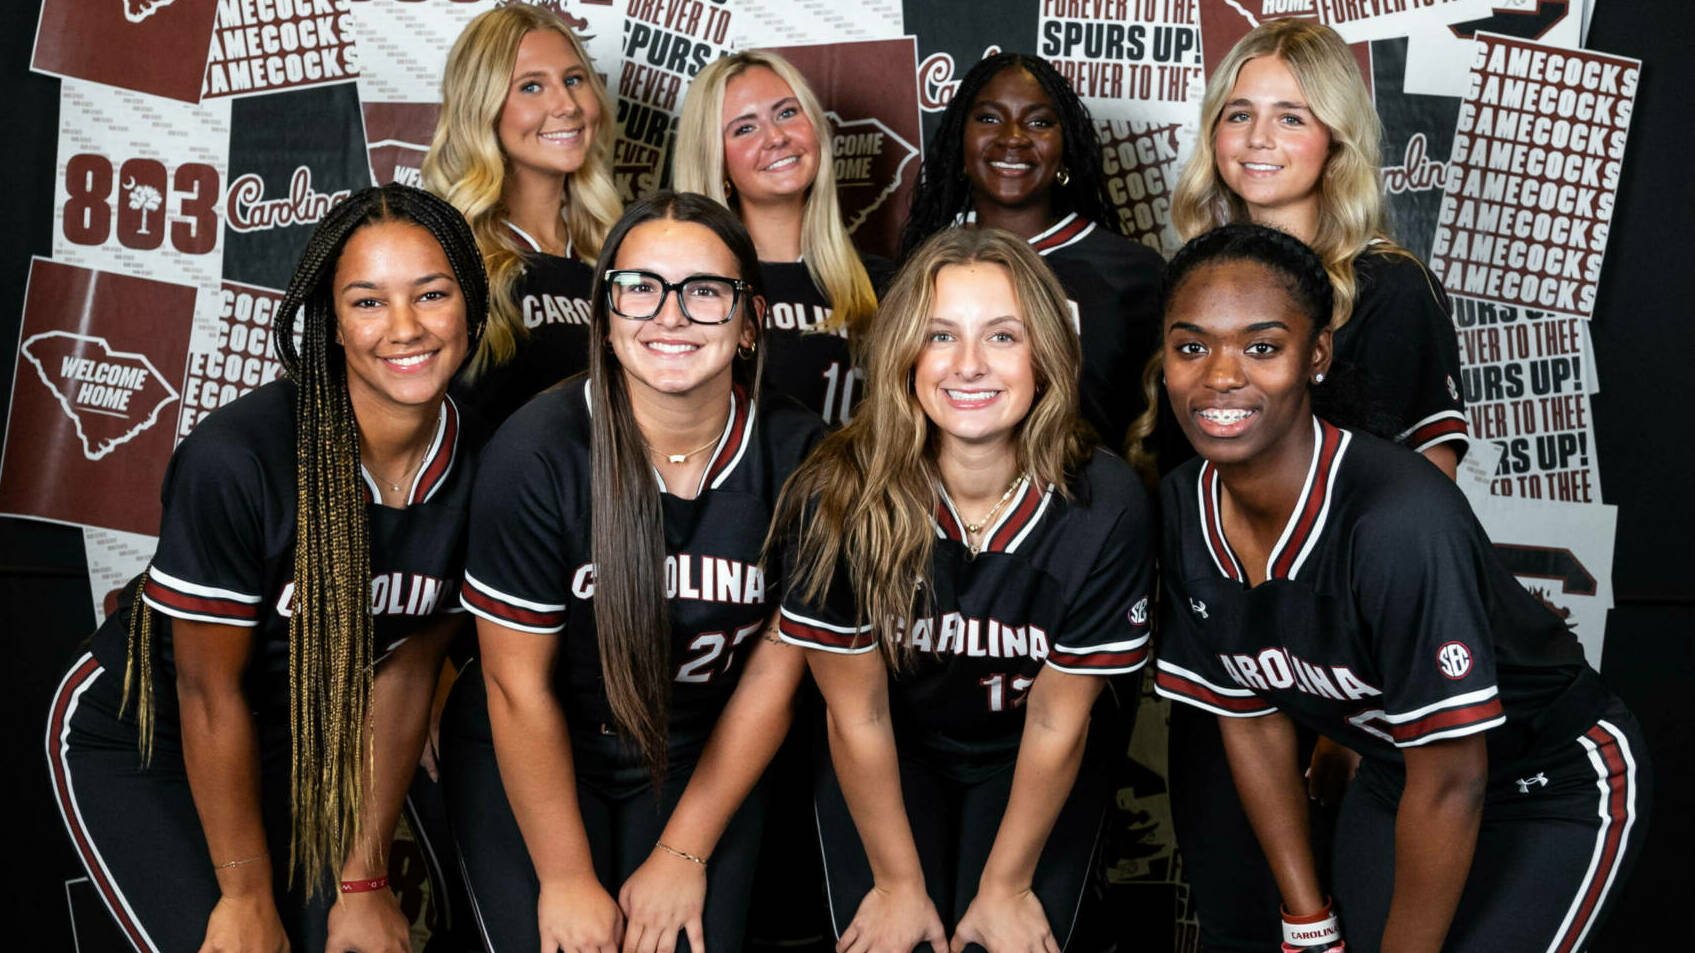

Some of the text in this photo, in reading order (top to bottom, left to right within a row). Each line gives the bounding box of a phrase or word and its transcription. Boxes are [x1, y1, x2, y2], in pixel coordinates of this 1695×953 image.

[703, 5, 731, 45] TO
[1042, 20, 1202, 64] SPURS UP!
[619, 60, 682, 112] REVER
[1129, 64, 1152, 100] TO
[1471, 40, 1639, 98] GAMECOCKS
[1465, 71, 1633, 129] GAMECOCKS
[1457, 103, 1627, 160] GAMECOCKS
[1451, 134, 1621, 190] GAMECOCKS
[62, 153, 221, 255] 803
[1445, 165, 1615, 222] GAMECOCKS
[1438, 196, 1609, 252] GAMECOCKS
[1433, 227, 1603, 283] GAMECOCKS
[1428, 257, 1597, 314] GAMECOCKS
[522, 293, 592, 329] CARO
[1504, 323, 1530, 361] TO
[1532, 318, 1580, 358] THEE
[61, 355, 149, 390] WELCOME
[184, 377, 253, 410] ECO
[1530, 356, 1582, 396] UP!
[76, 381, 133, 412] HOME
[1464, 394, 1587, 440] VER TO THEE
[1536, 431, 1589, 471] UP!
[1545, 468, 1593, 504] THEE
[571, 553, 765, 603] COLINA
[1438, 642, 1471, 678] SEC
